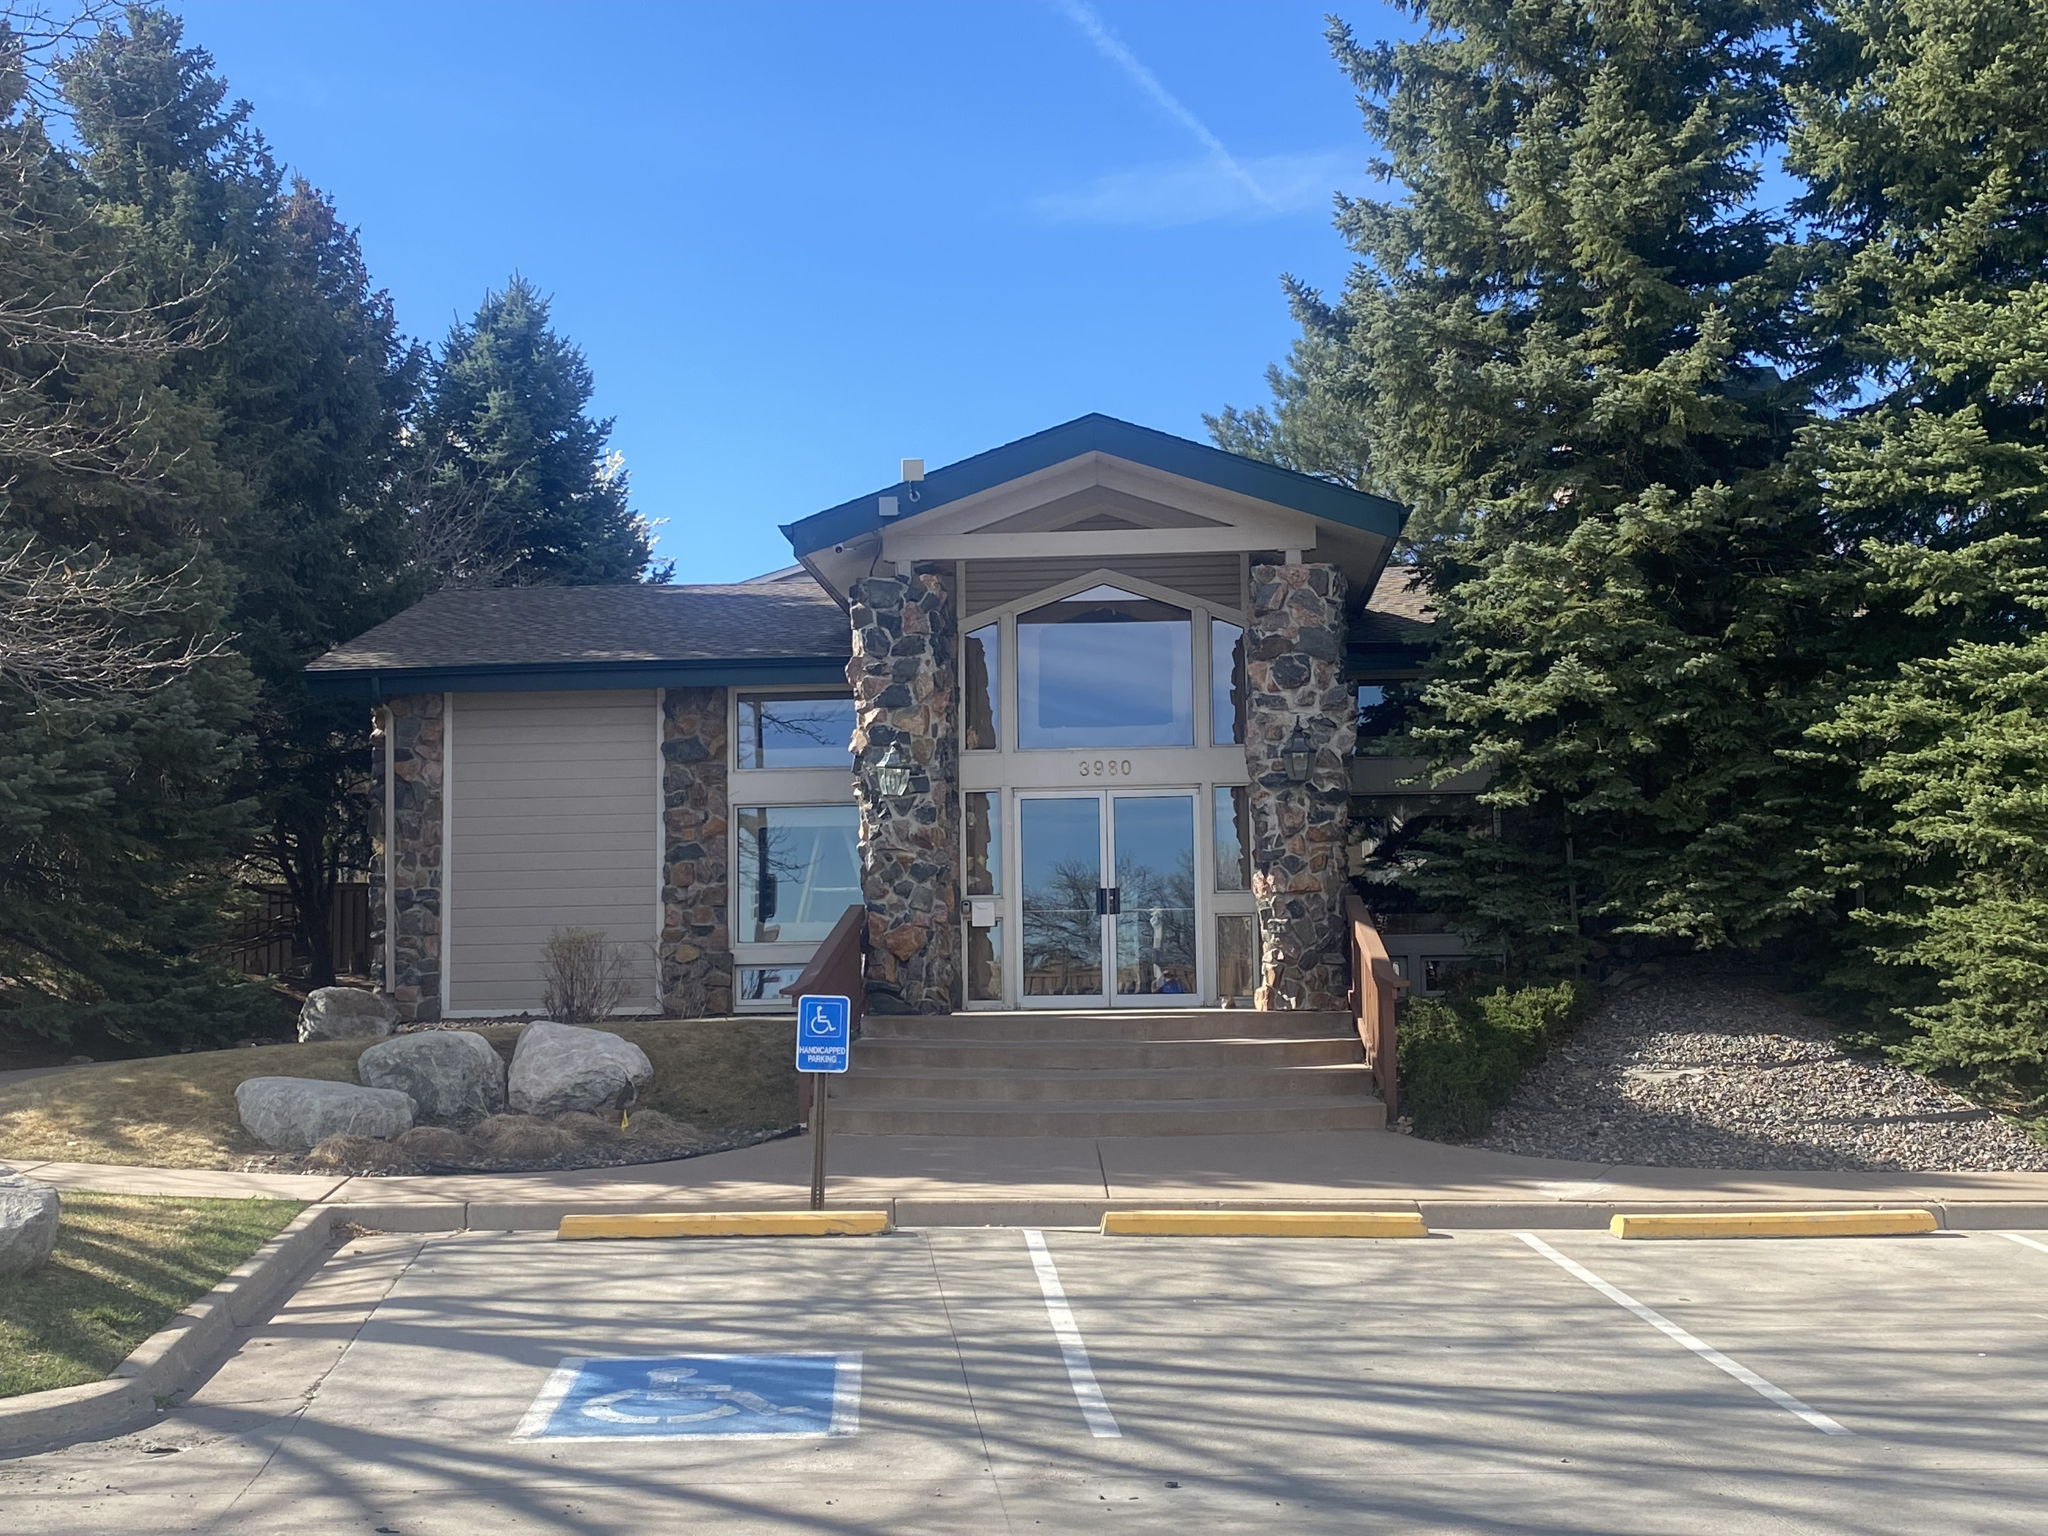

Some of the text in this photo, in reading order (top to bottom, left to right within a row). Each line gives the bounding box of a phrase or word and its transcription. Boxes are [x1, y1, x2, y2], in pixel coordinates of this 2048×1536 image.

[1079, 760, 1132, 776] 3980
[800, 1046, 846, 1055] HANDICAPPED
[807, 1055, 837, 1063] PARKING
